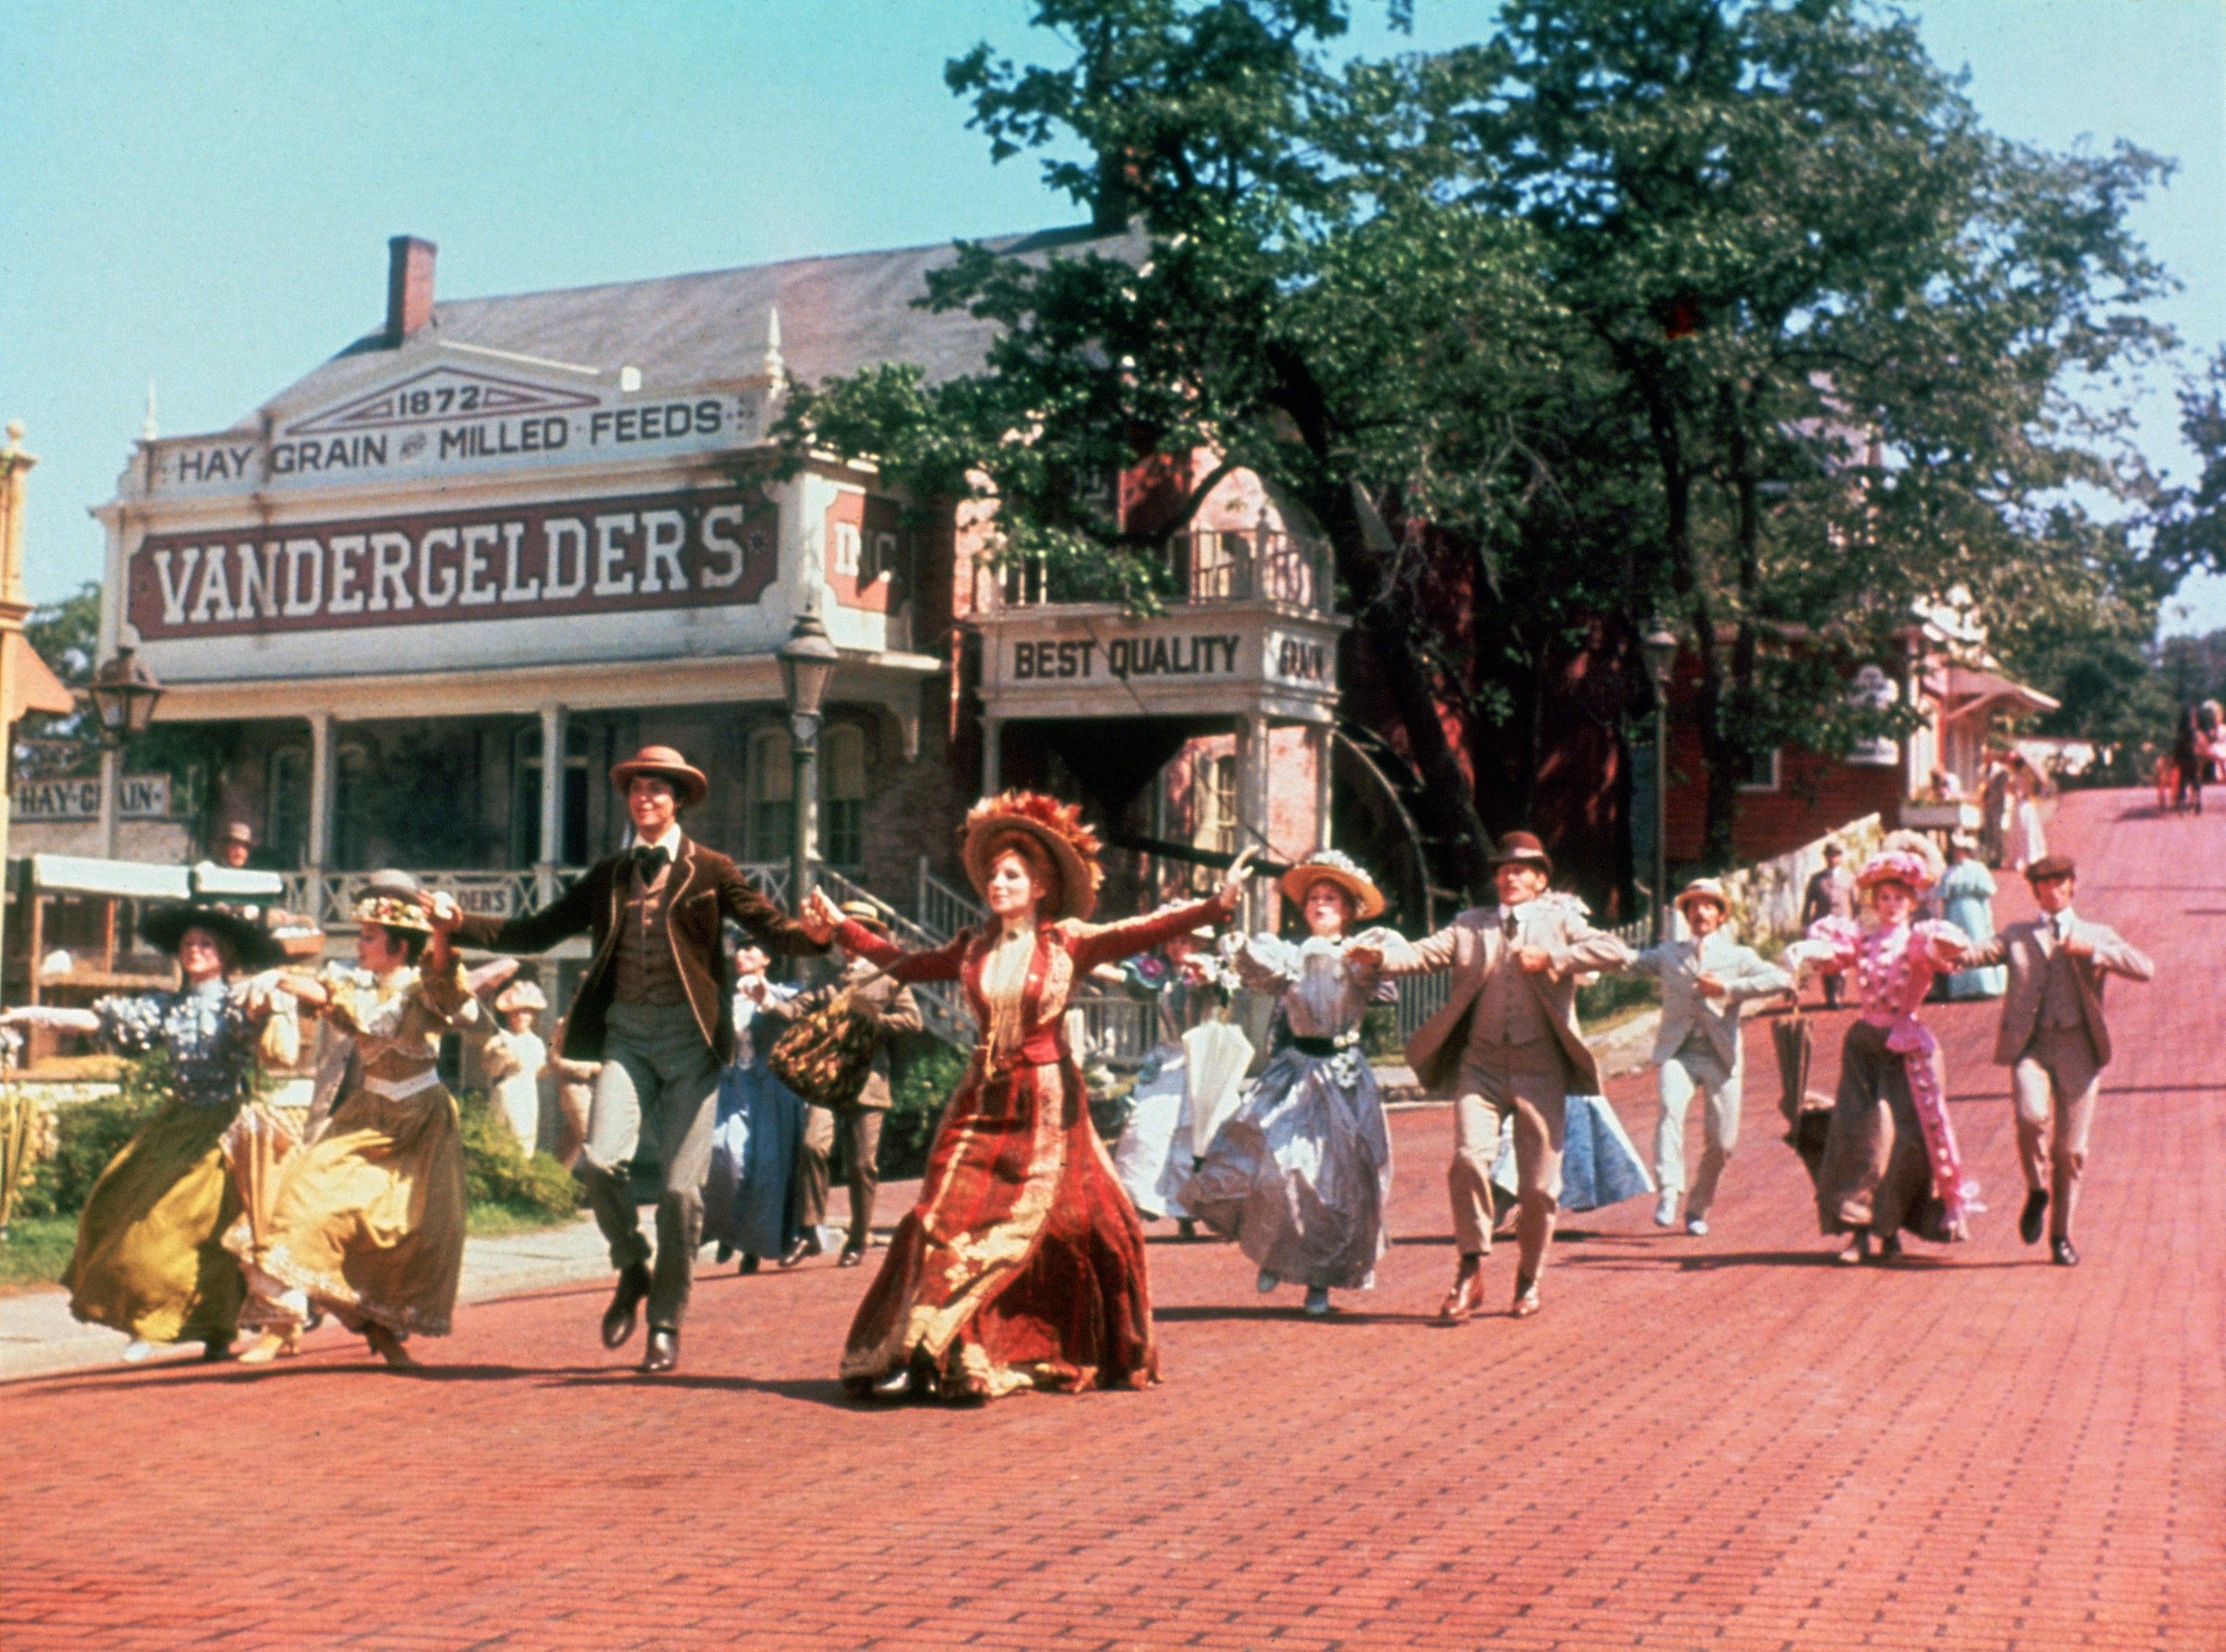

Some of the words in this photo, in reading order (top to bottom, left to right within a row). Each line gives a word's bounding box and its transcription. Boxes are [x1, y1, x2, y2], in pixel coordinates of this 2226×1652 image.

[398, 385, 481, 417] 1872
[179, 445, 252, 482] HAY
[269, 433, 387, 474] GRAIN
[439, 416, 569, 460] MILLED
[591, 401, 722, 444] FEEDS
[154, 504, 743, 624] VANDERGELDER'S
[1015, 640, 1097, 679] BEST
[1108, 634, 1241, 681] QUALITY
